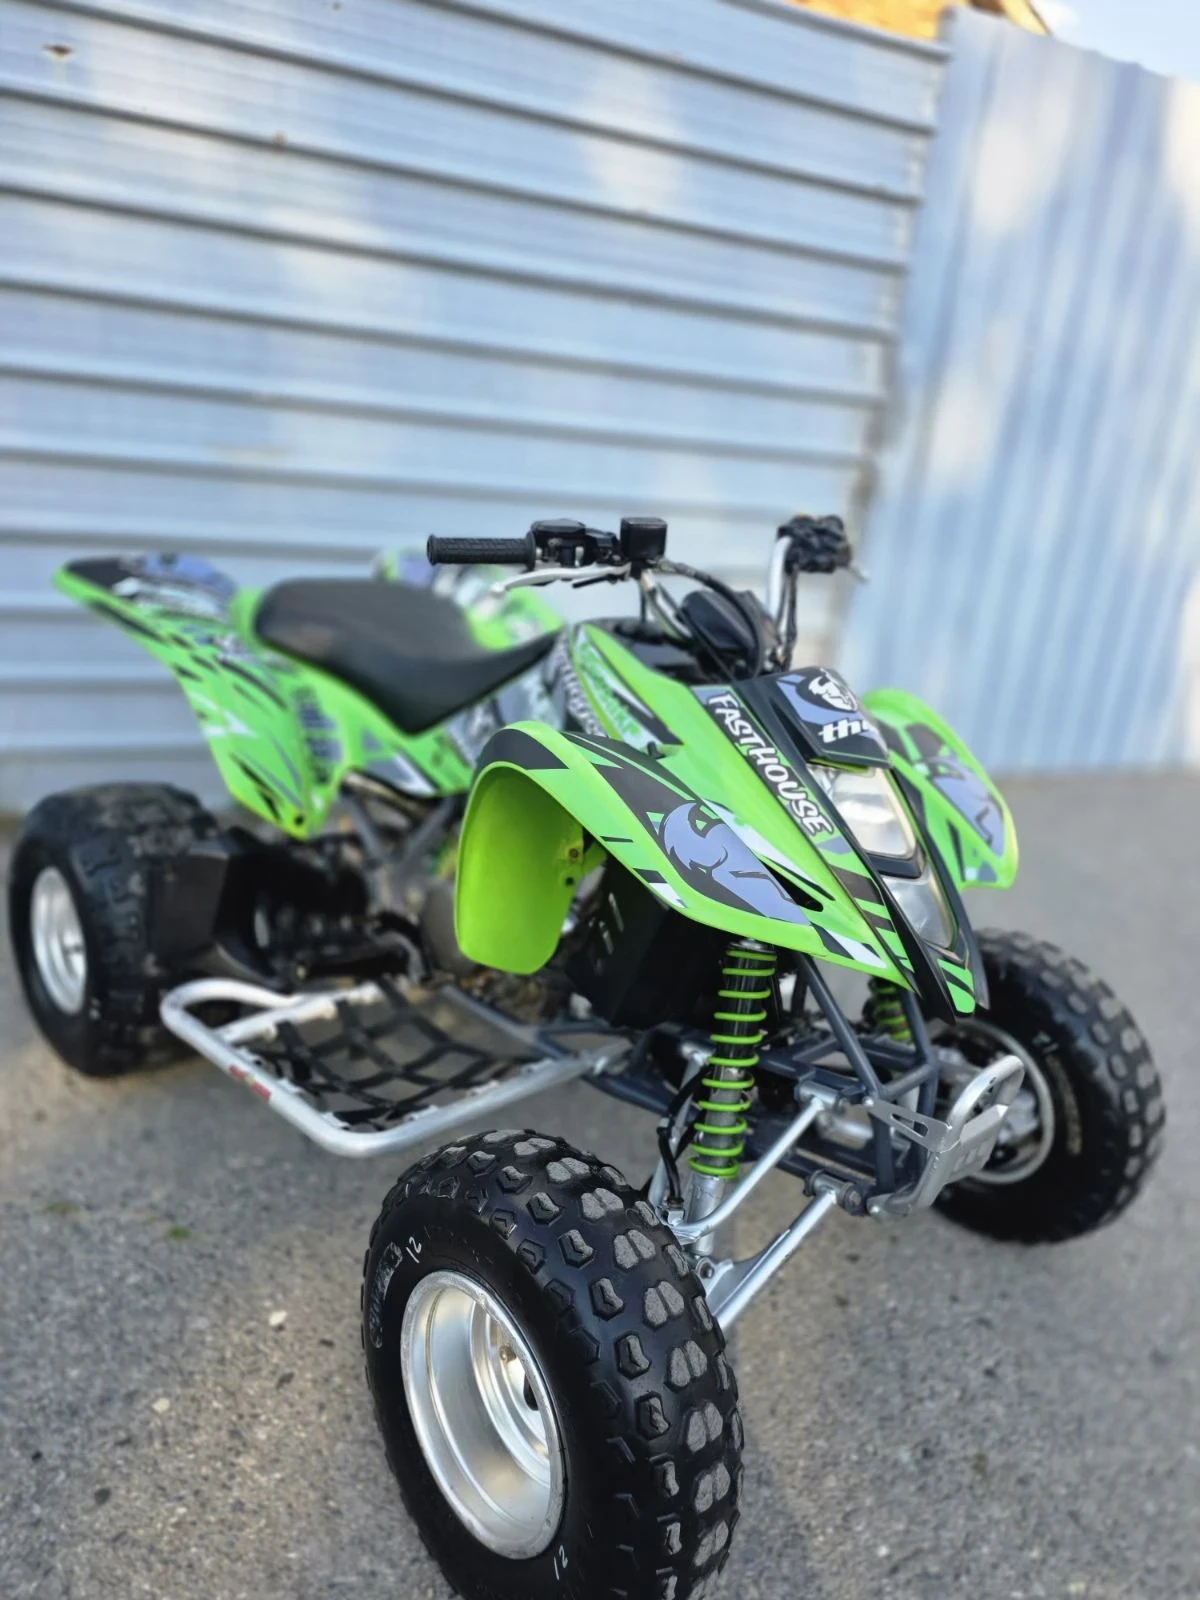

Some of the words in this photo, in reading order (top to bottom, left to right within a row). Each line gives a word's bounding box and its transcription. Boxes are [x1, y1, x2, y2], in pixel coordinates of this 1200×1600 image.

[708, 692, 834, 836] FASTHOUSE
[405, 1236, 422, 1264] 12
[553, 1544, 568, 1581] 12
